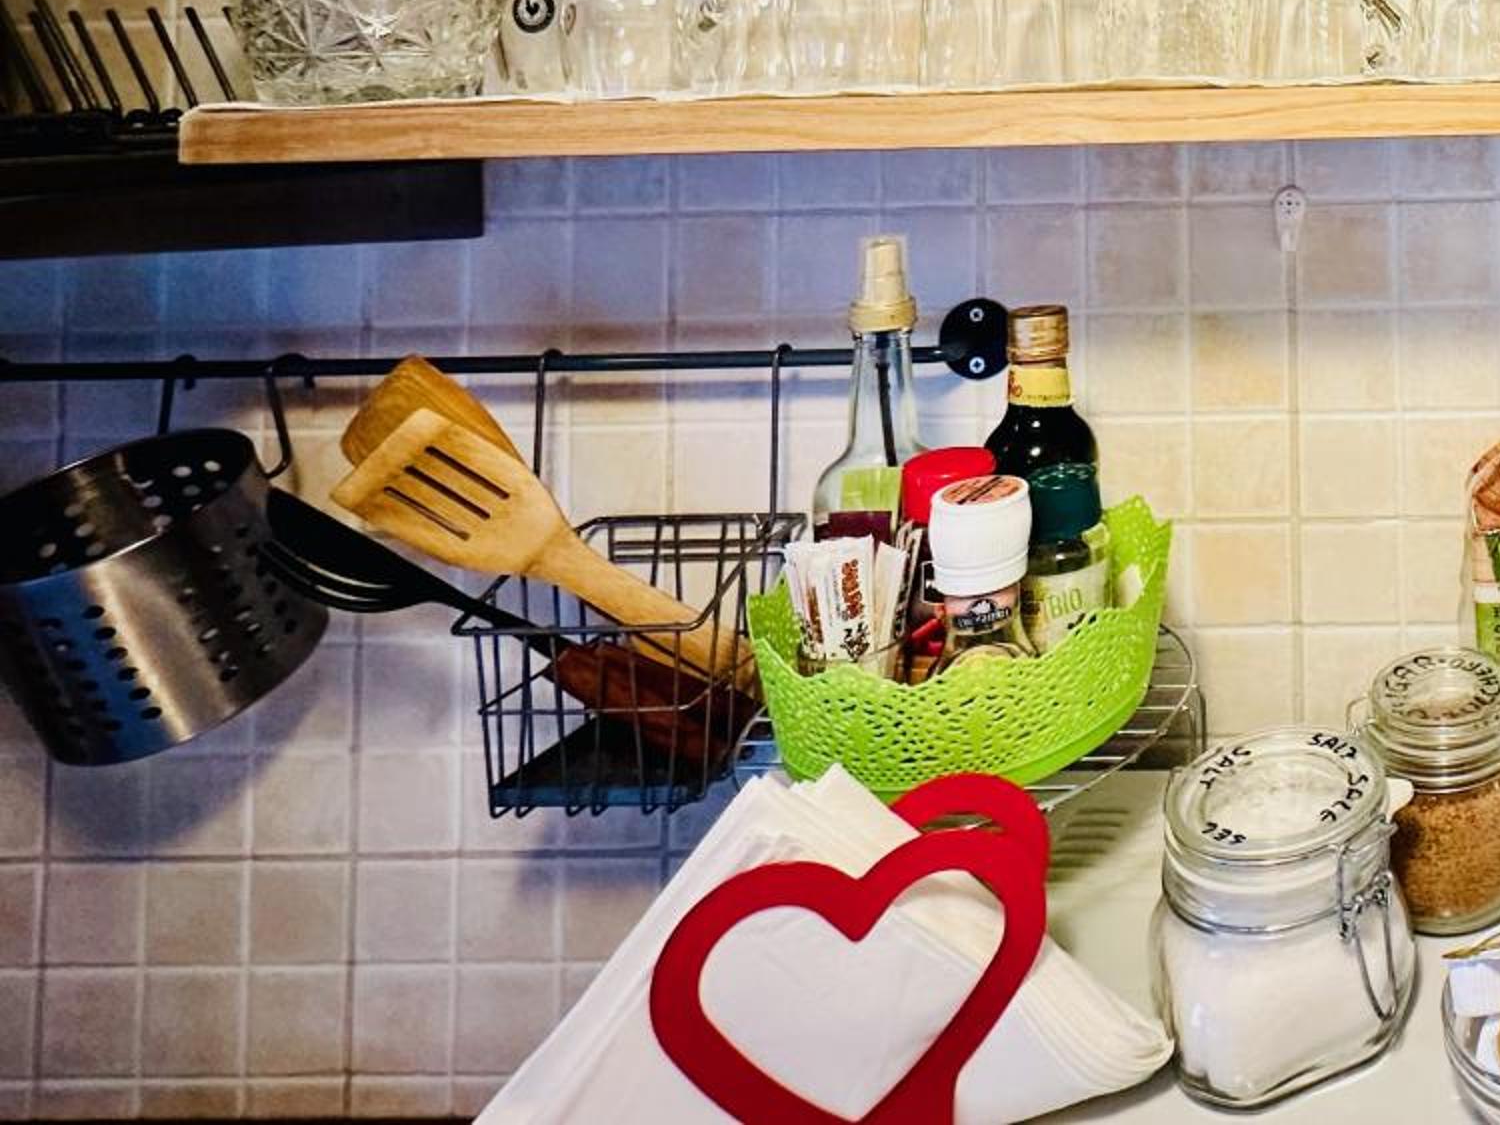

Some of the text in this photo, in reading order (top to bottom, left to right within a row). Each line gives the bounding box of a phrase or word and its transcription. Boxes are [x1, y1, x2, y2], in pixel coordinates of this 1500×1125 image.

[1050, 588, 1083, 620] BIO
[1200, 746, 1251, 790] SALT
[1319, 771, 1370, 823] SALE
[1201, 821, 1248, 846] SEL
